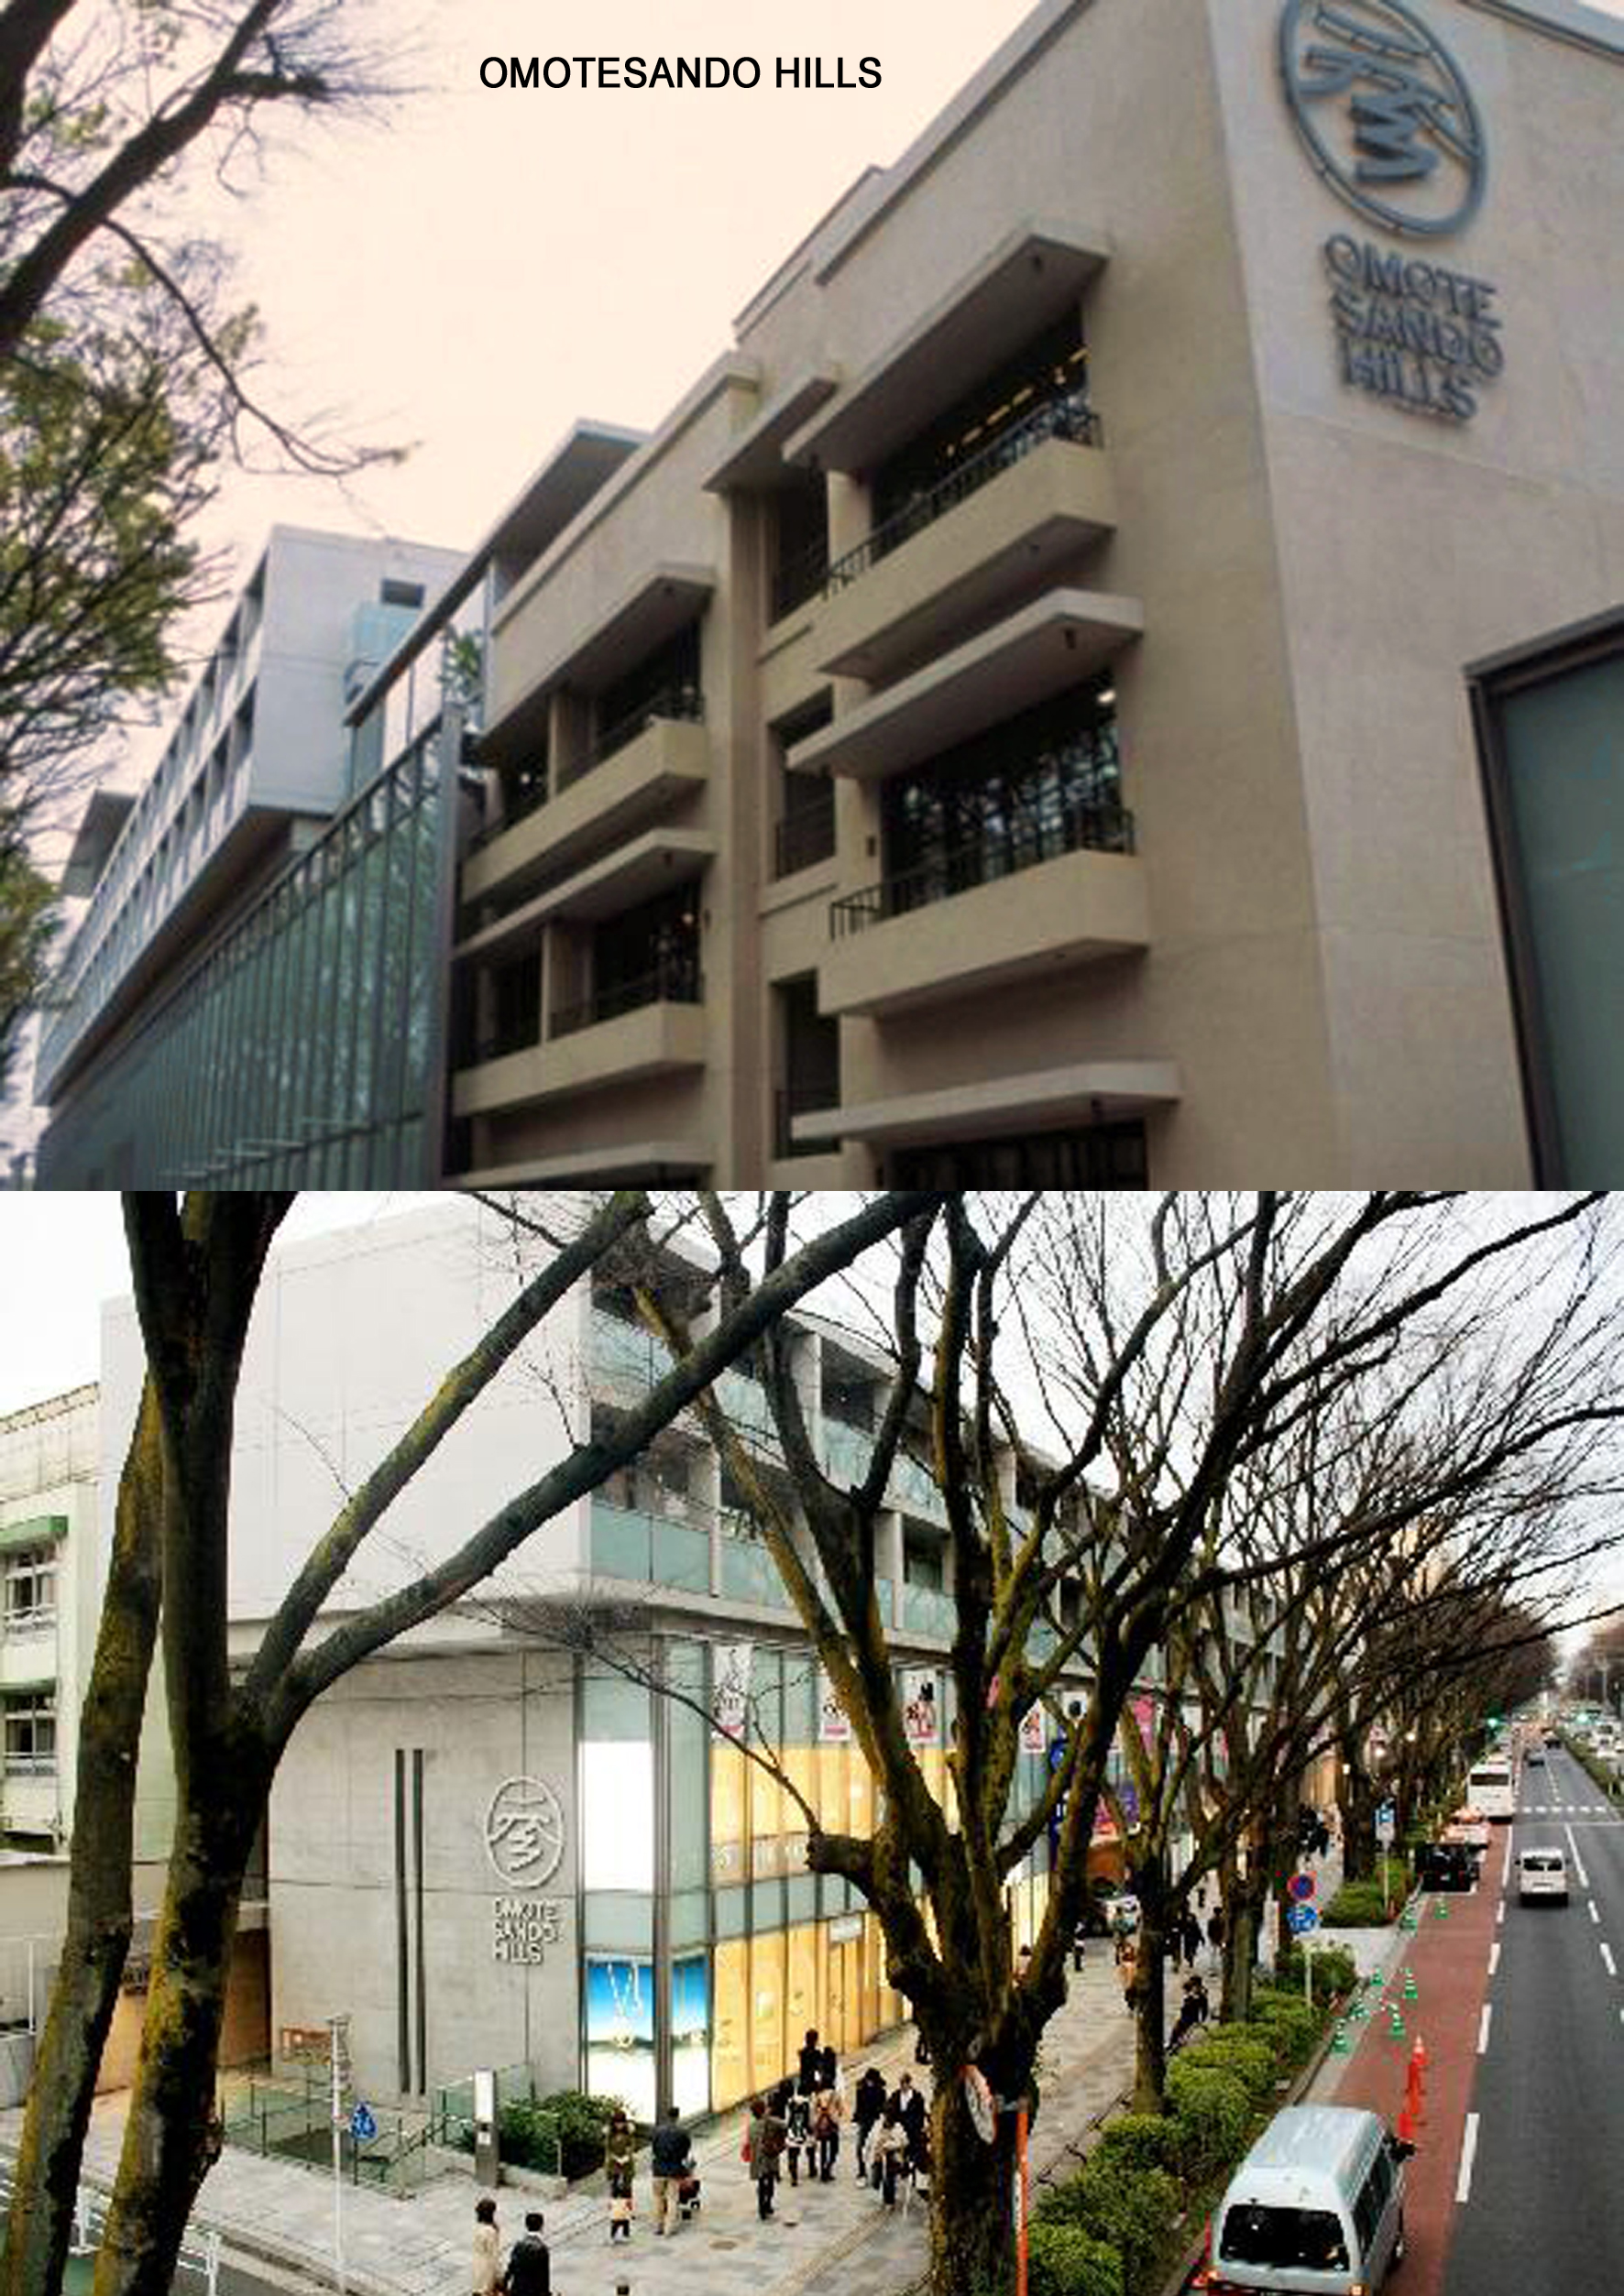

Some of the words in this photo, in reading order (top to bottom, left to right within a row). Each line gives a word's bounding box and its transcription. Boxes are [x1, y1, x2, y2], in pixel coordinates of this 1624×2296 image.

[1324, 234, 1501, 329] OMOTE
[1332, 288, 1505, 377] SANDO
[1341, 336, 1478, 420] HILLS
[493, 1941, 544, 1965] HILLS
